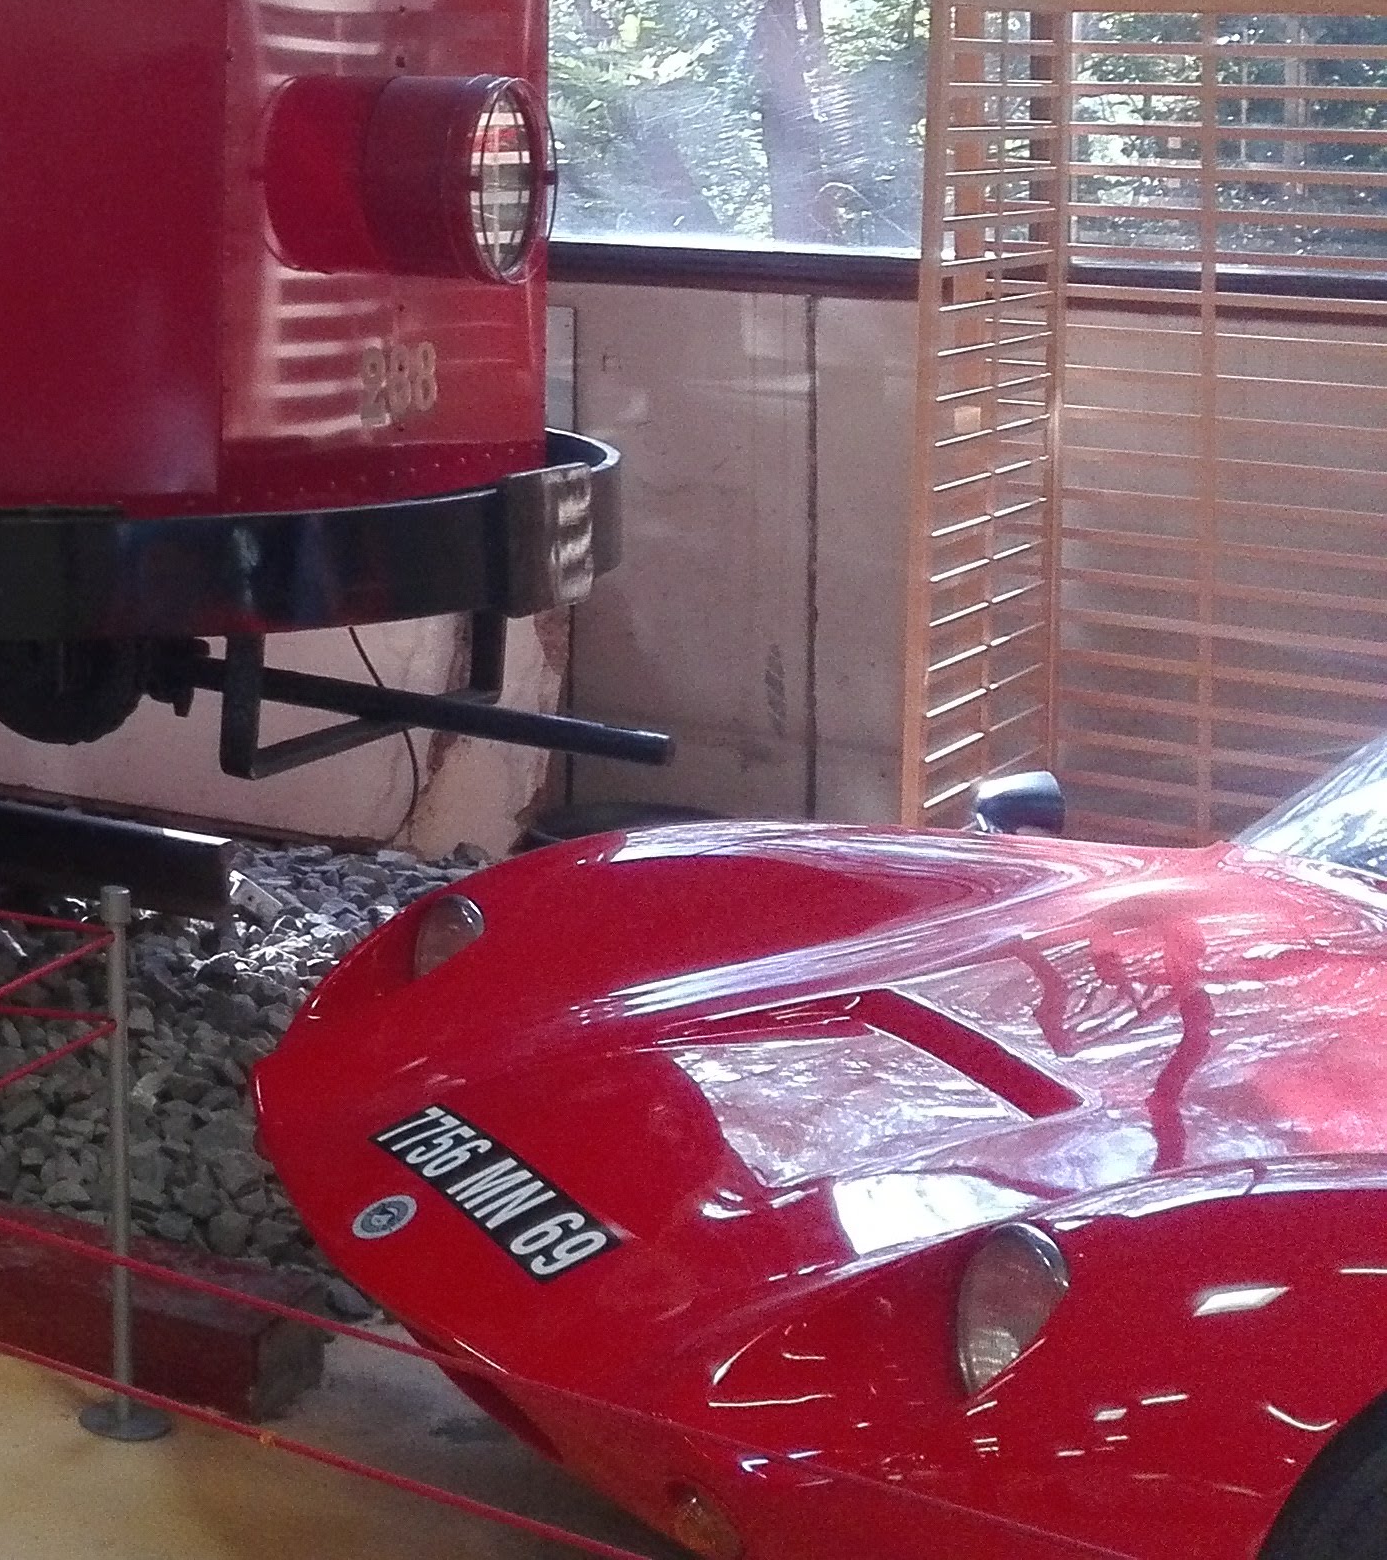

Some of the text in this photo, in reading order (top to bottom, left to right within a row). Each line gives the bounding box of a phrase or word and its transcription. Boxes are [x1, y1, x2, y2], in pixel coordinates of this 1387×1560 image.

[360, 342, 437, 427] 288
[377, 1105, 608, 1275] 7756 MN 69
